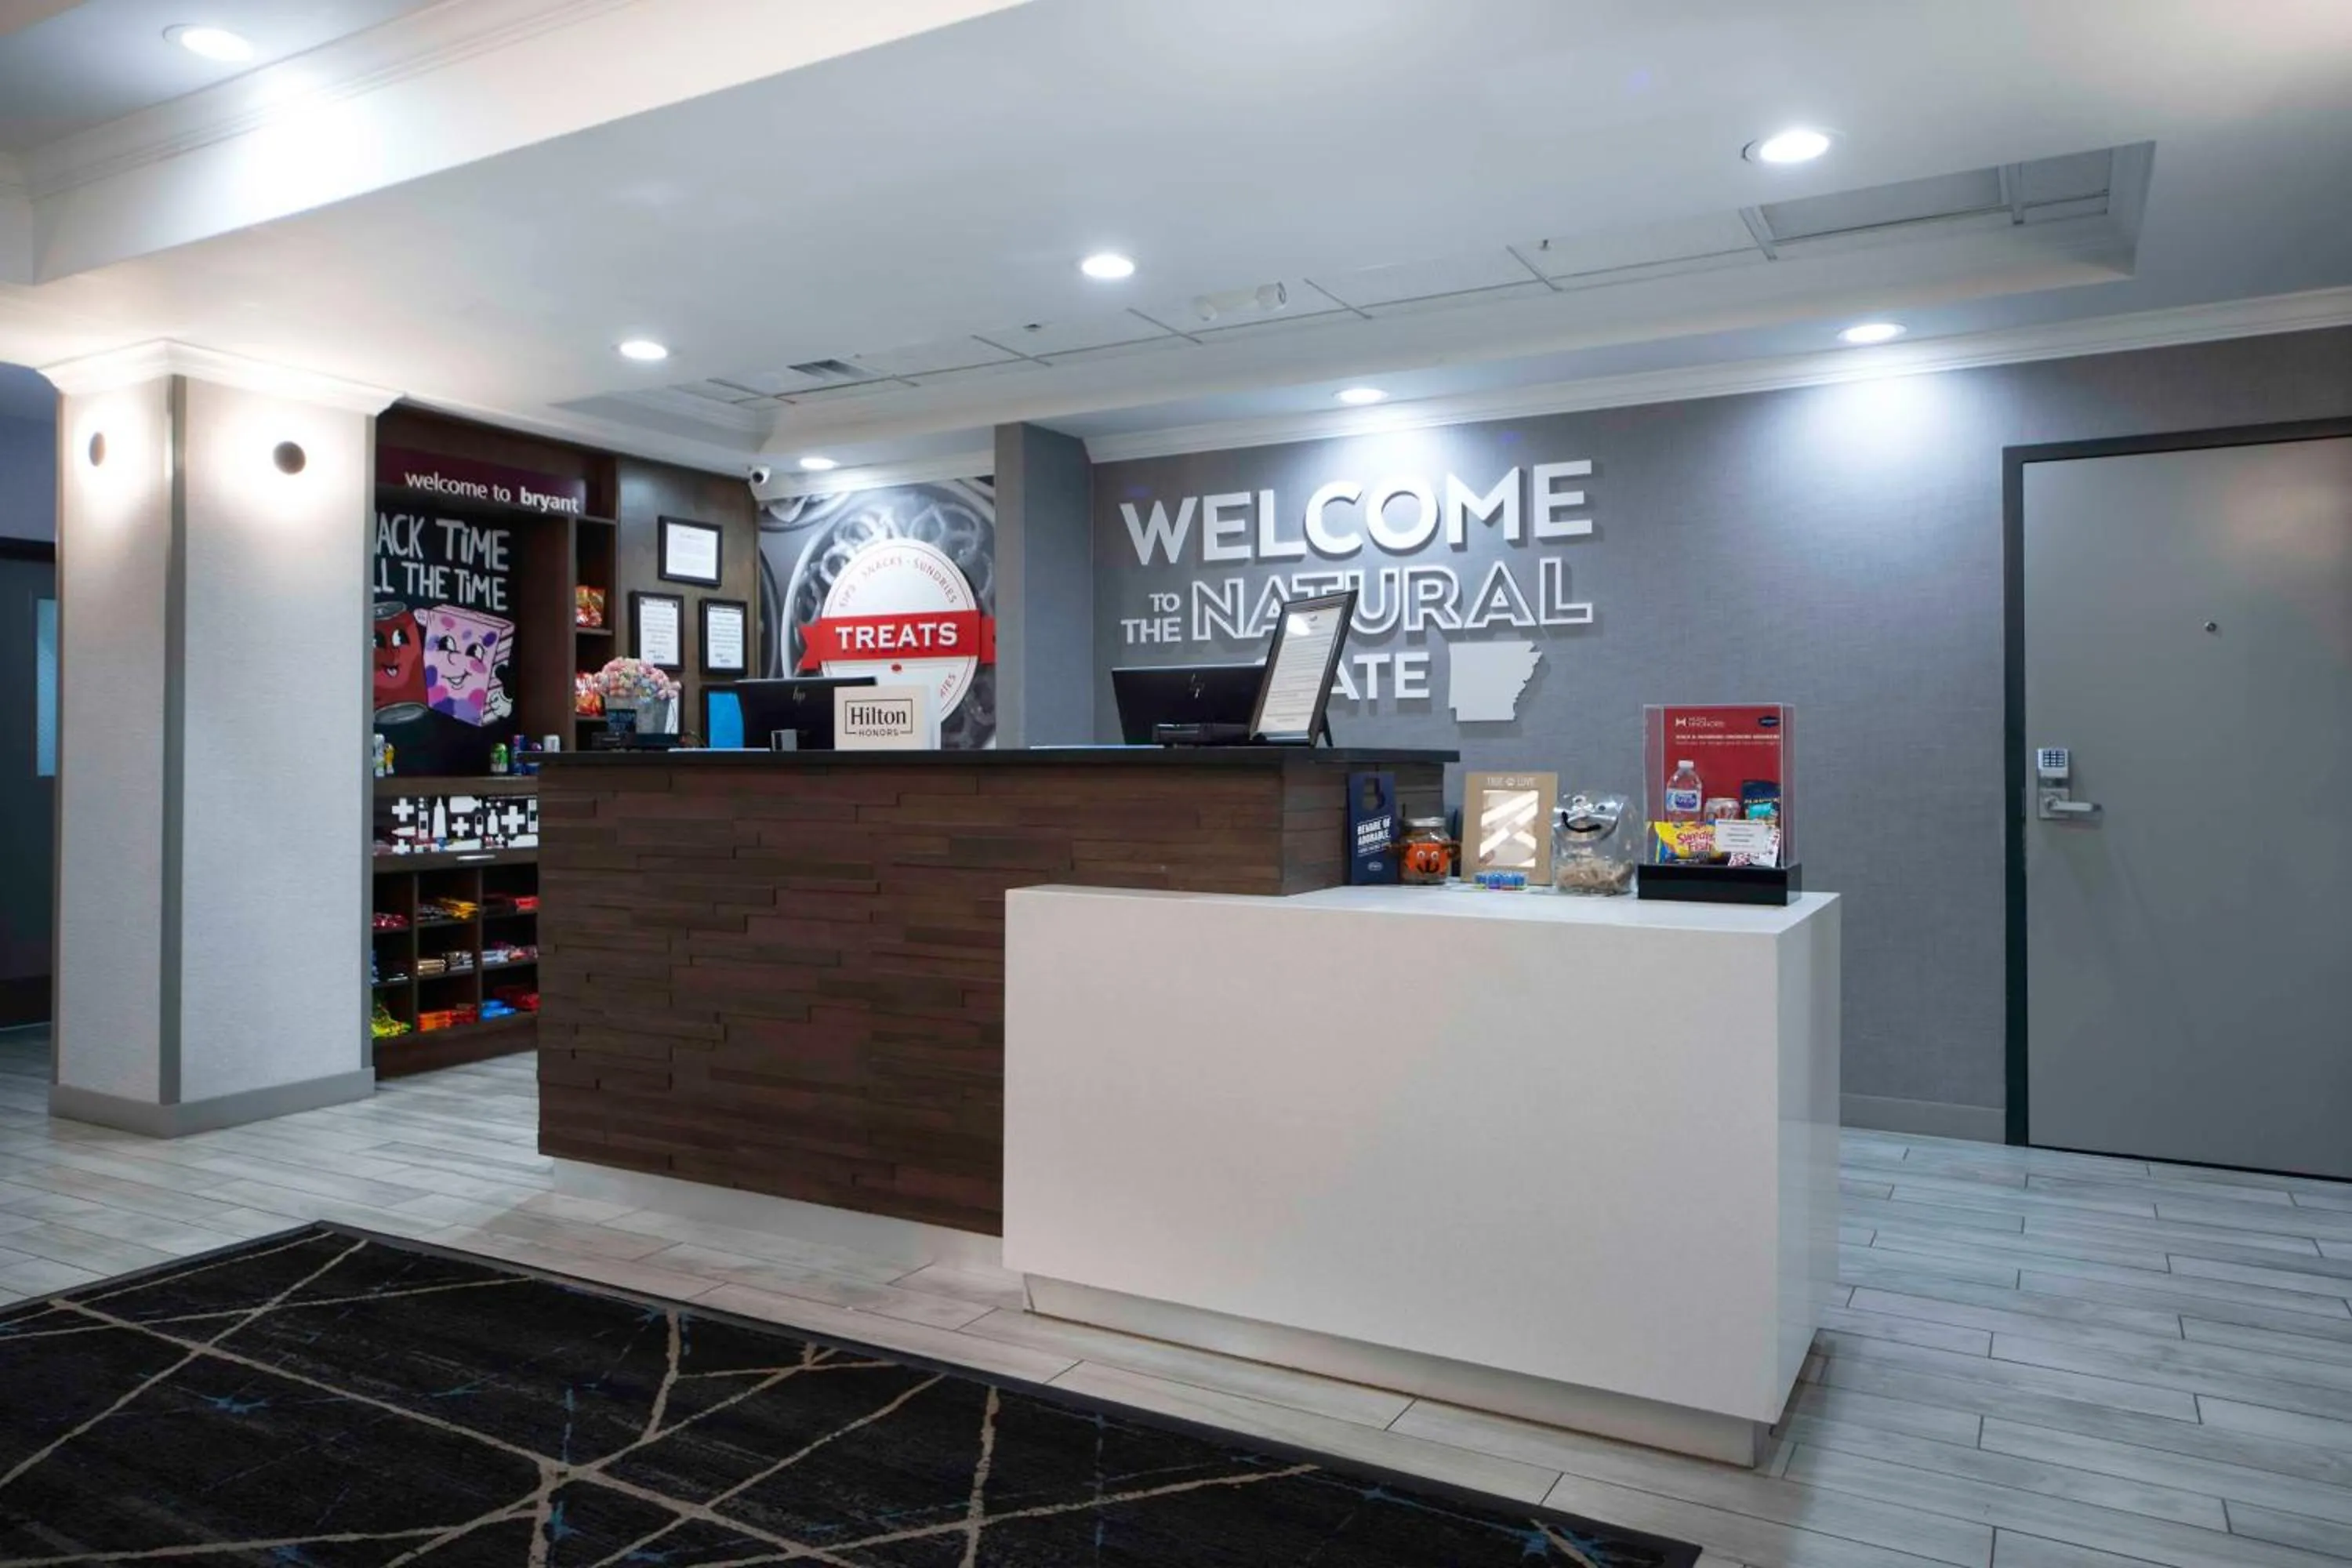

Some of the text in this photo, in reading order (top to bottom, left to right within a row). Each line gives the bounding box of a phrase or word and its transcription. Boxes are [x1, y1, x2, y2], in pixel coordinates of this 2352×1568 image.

[405, 471, 579, 514] welcome to bryant
[1120, 459, 1593, 565] WELCOME
[376, 512, 426, 559] ACK
[401, 561, 450, 600] THE
[913, 557, 958, 604] SUNDRIES
[1149, 593, 1180, 612] TO
[835, 622, 958, 650] TREATS
[1120, 617, 1181, 643] THE
[851, 706, 906, 725] Hilton
[858, 728, 899, 737] HONORS
